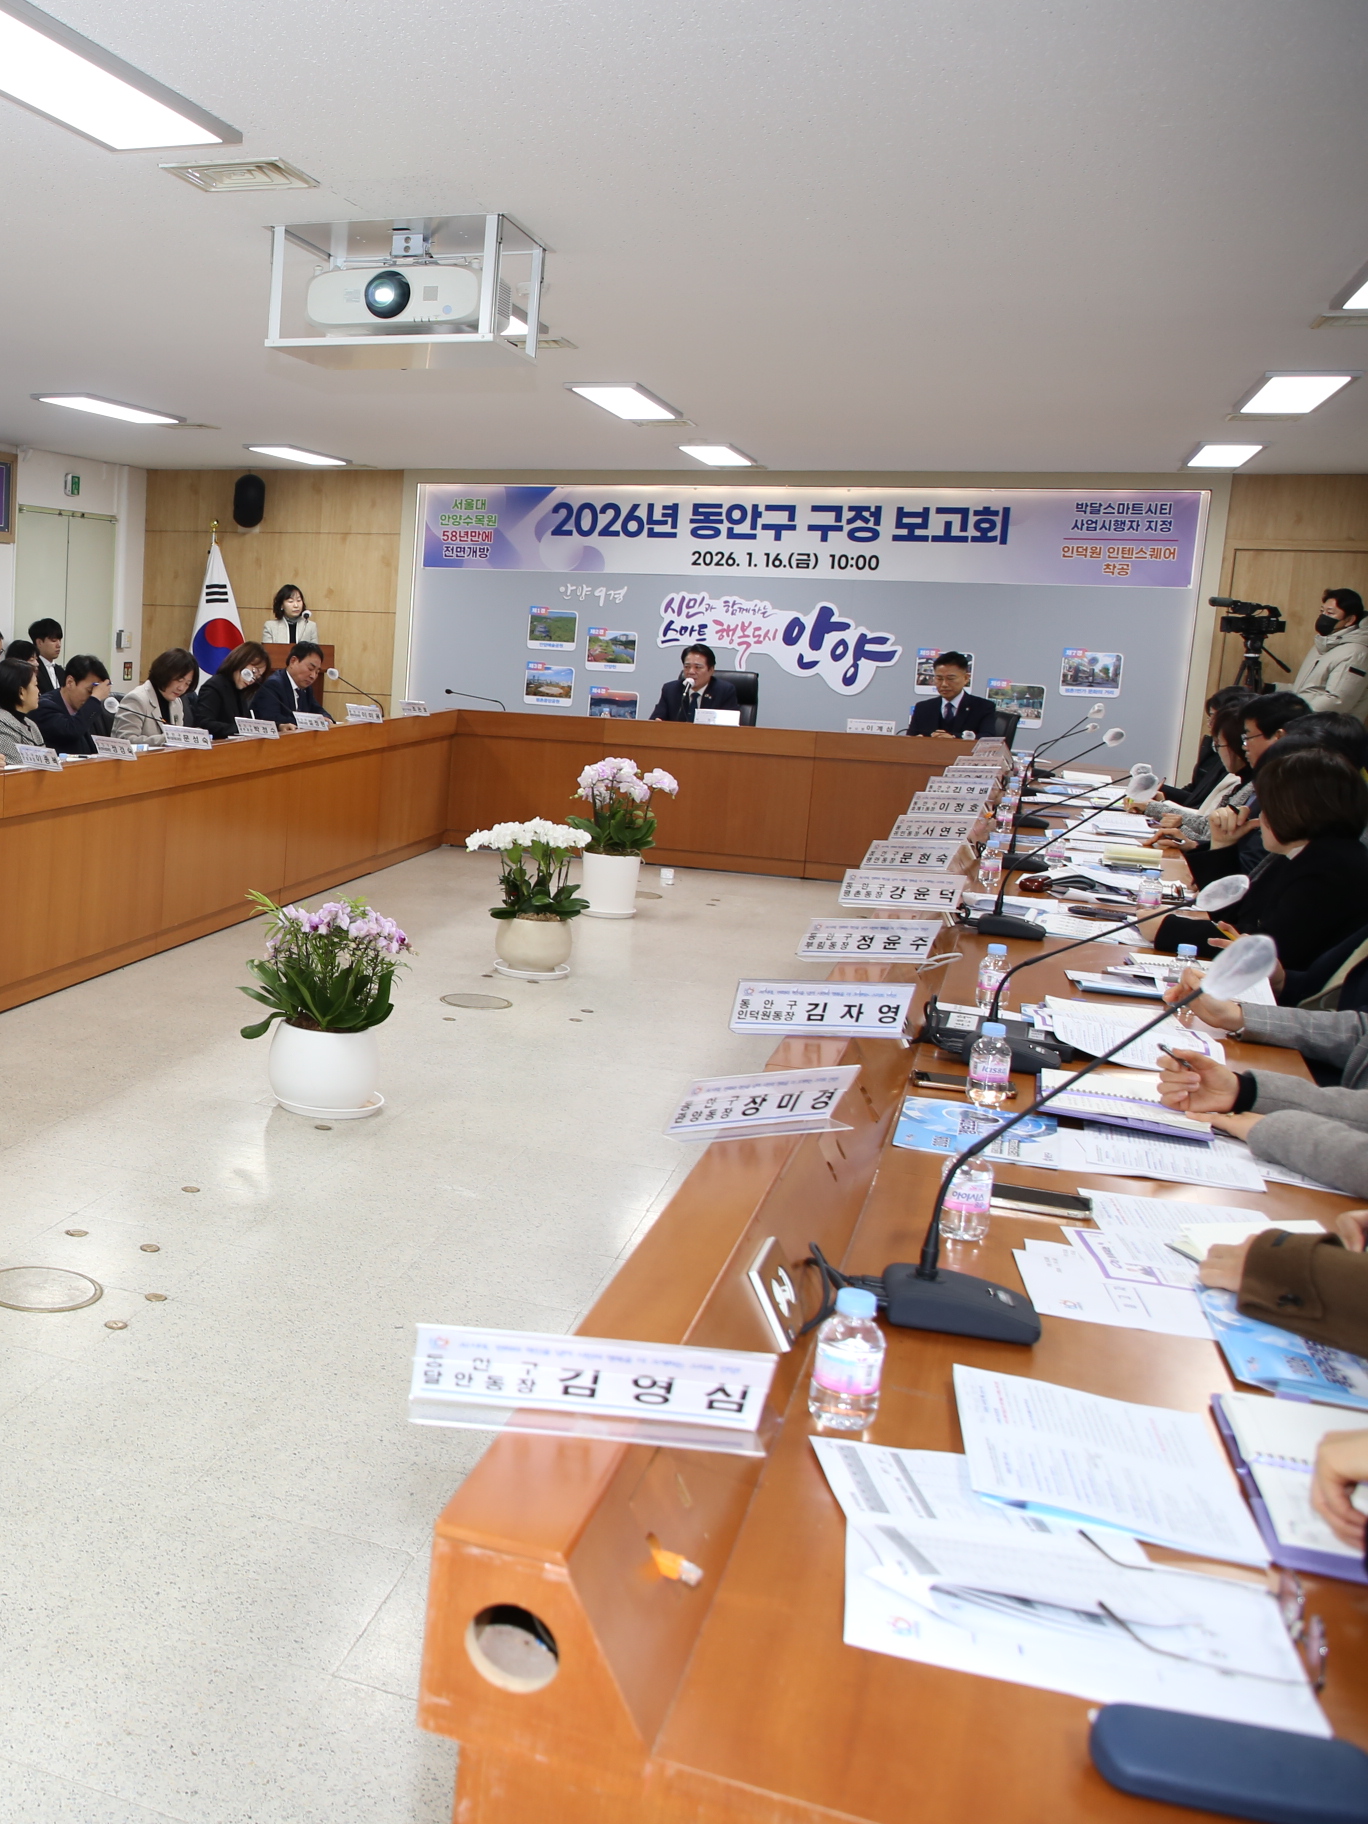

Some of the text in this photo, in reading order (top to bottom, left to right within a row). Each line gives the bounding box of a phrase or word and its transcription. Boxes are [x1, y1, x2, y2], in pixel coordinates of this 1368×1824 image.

[451, 497, 487, 512] 서울대
[1074, 501, 1173, 516] 박달스마트시티
[439, 513, 498, 528] 안양수목원
[550, 502, 1011, 545] 2026년 동안구 구정 보고회
[1070, 518, 1173, 534] 사업시행자 지정
[441, 529, 494, 544] 58년만에
[442, 545, 490, 559] 전면개방
[1061, 544, 1177, 561] 인덕원 인텐스퀘어
[691, 552, 880, 571] 2026. 1. 16.(금) 10:00
[1102, 562, 1130, 577] 착공
[663, 595, 717, 619] 시민과
[661, 619, 779, 669] 스마트 행복도시
[782, 605, 898, 687] 안양
[922, 826, 967, 837] 서연우
[899, 851, 948, 865] 문현숙
[889, 885, 956, 903] 강윤덕
[856, 934, 929, 951] 정윤주
[805, 1002, 901, 1024] 김자영
[741, 1087, 838, 1117] 장미경
[558, 1366, 750, 1414] 김영심
